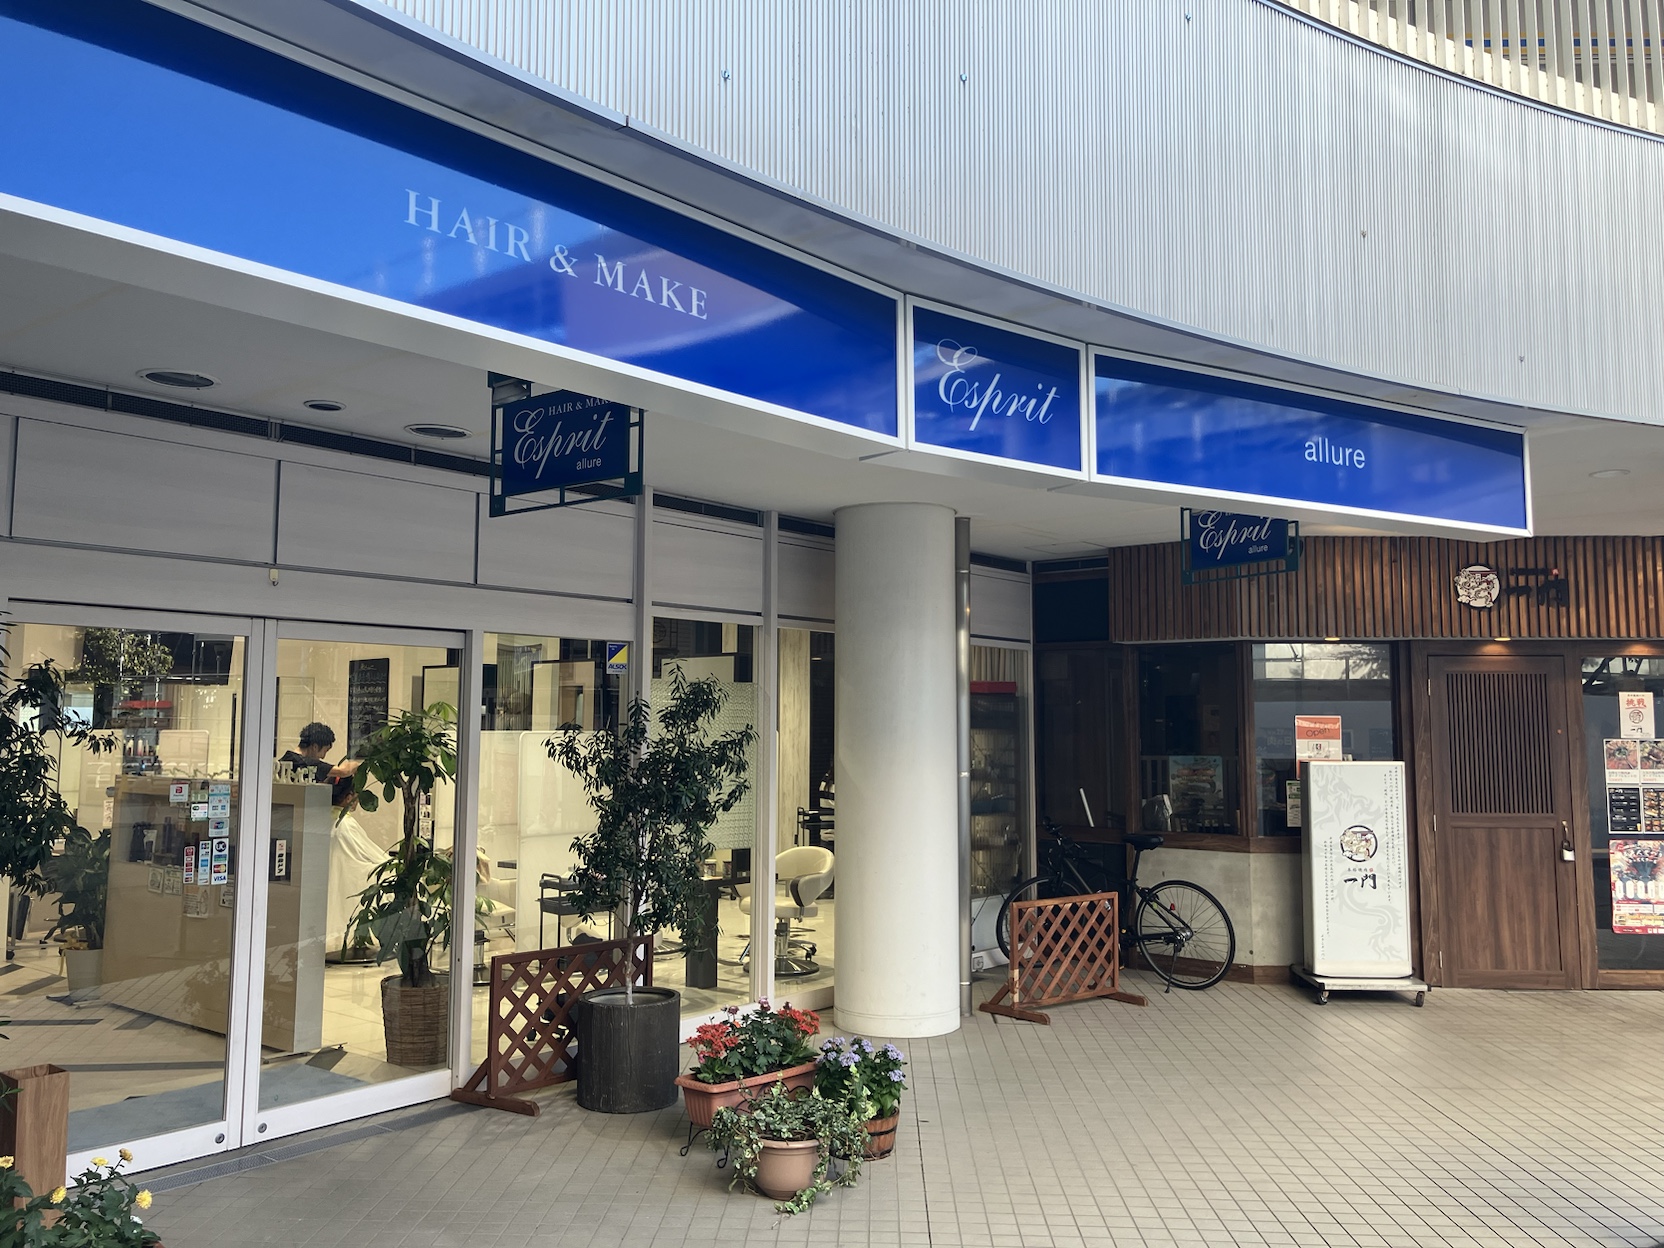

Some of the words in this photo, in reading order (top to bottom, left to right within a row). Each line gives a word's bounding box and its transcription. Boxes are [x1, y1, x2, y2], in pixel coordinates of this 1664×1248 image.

[404, 188, 534, 264] HAIR
[549, 244, 579, 278] &
[593, 252, 708, 320] MAKE
[937, 338, 1060, 431] Esprit
[548, 403, 573, 416] HAIR
[575, 402, 583, 411] &
[585, 398, 612, 408] MAK
[513, 408, 614, 479] Esprit
[1304, 436, 1365, 469] allure
[576, 457, 602, 471] allure
[1198, 510, 1271, 560] Esprit
[1248, 544, 1268, 554] allure
[1344, 874, 1377, 890] 一門
